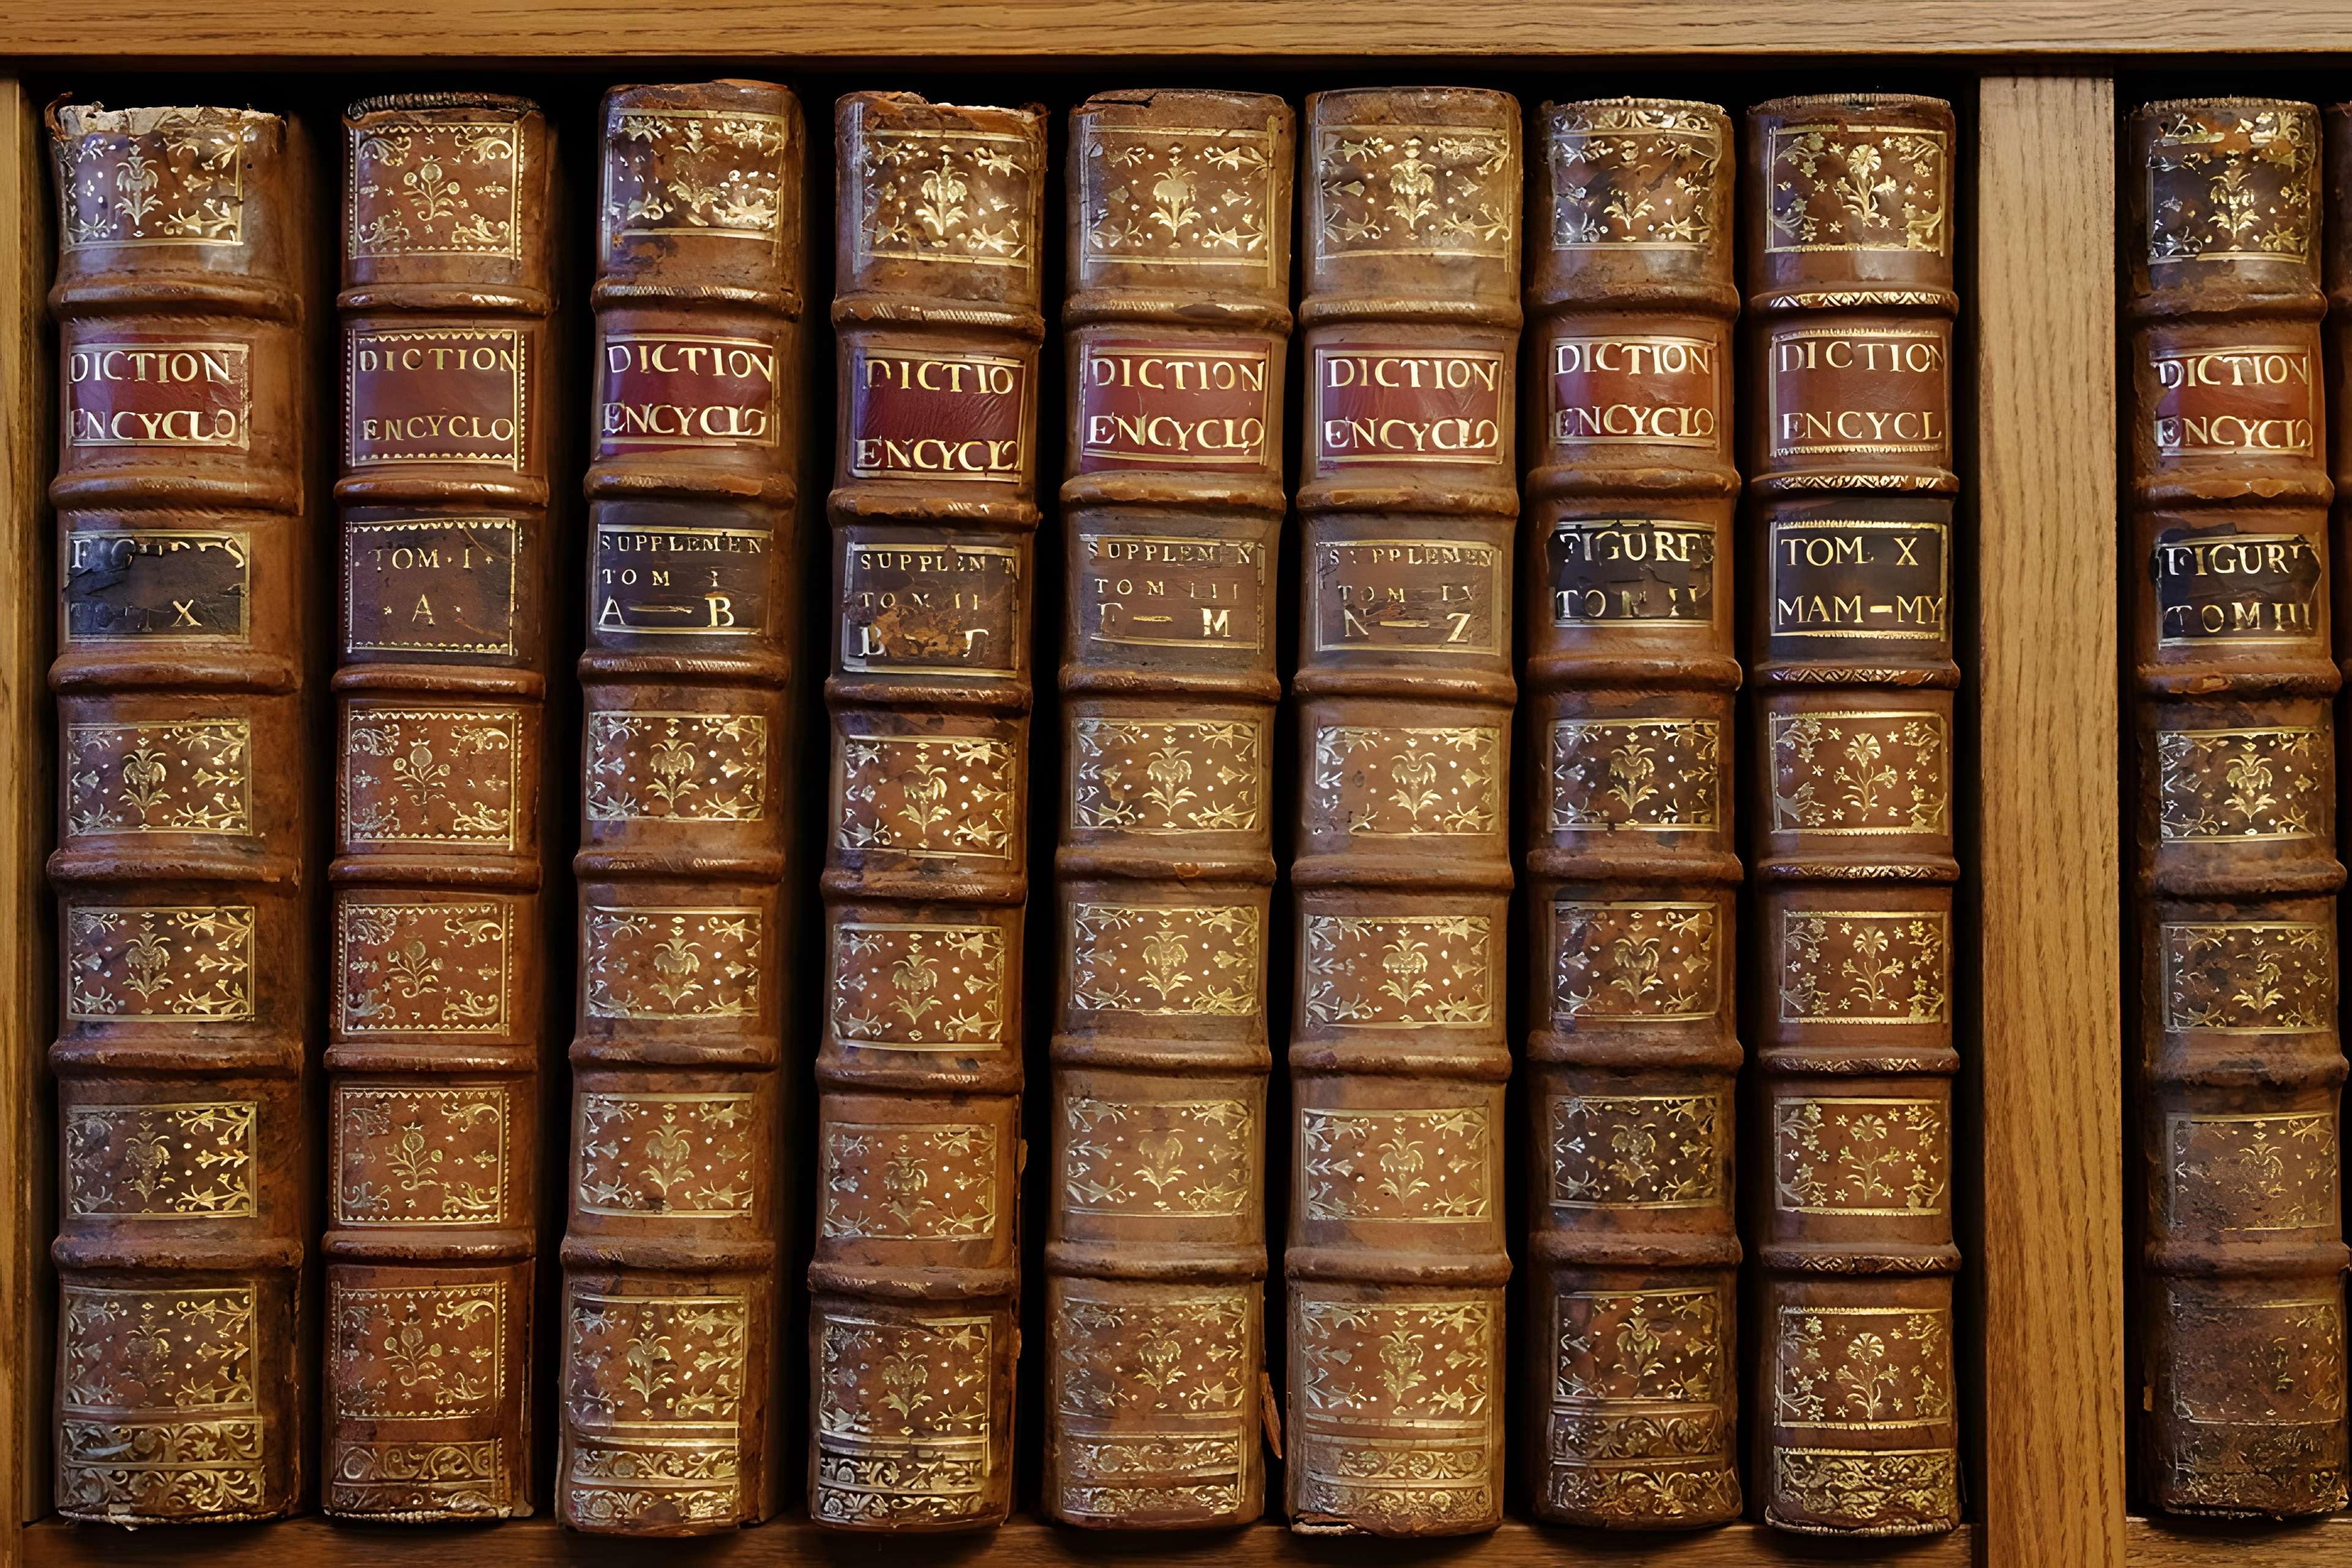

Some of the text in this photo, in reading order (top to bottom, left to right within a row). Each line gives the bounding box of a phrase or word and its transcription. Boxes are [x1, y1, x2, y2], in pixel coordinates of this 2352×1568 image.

[70, 351, 233, 384] DICTION
[359, 348, 516, 371] DICTION
[608, 344, 773, 382] DICTION
[1555, 342, 1711, 375] DICTION
[1779, 341, 1943, 372] DICTION
[2152, 355, 2308, 388] DICTION
[1090, 358, 1265, 391] DICTION
[1327, 358, 1498, 391] DICTION
[70, 409, 236, 440] ENCYCLO
[363, 416, 514, 441] ENCYCLO
[602, 402, 767, 437] ENCYCLO
[1087, 412, 1265, 451] ENCYCLO
[1324, 417, 1498, 451] ENCYCLO
[1556, 404, 1714, 437] ENCYCLO
[1782, 411, 1942, 440] ENCYCL
[1893, 537, 1918, 566] X
[1095, 579, 1164, 595] TOM
[171, 599, 203, 627] X
[412, 594, 435, 626] A
